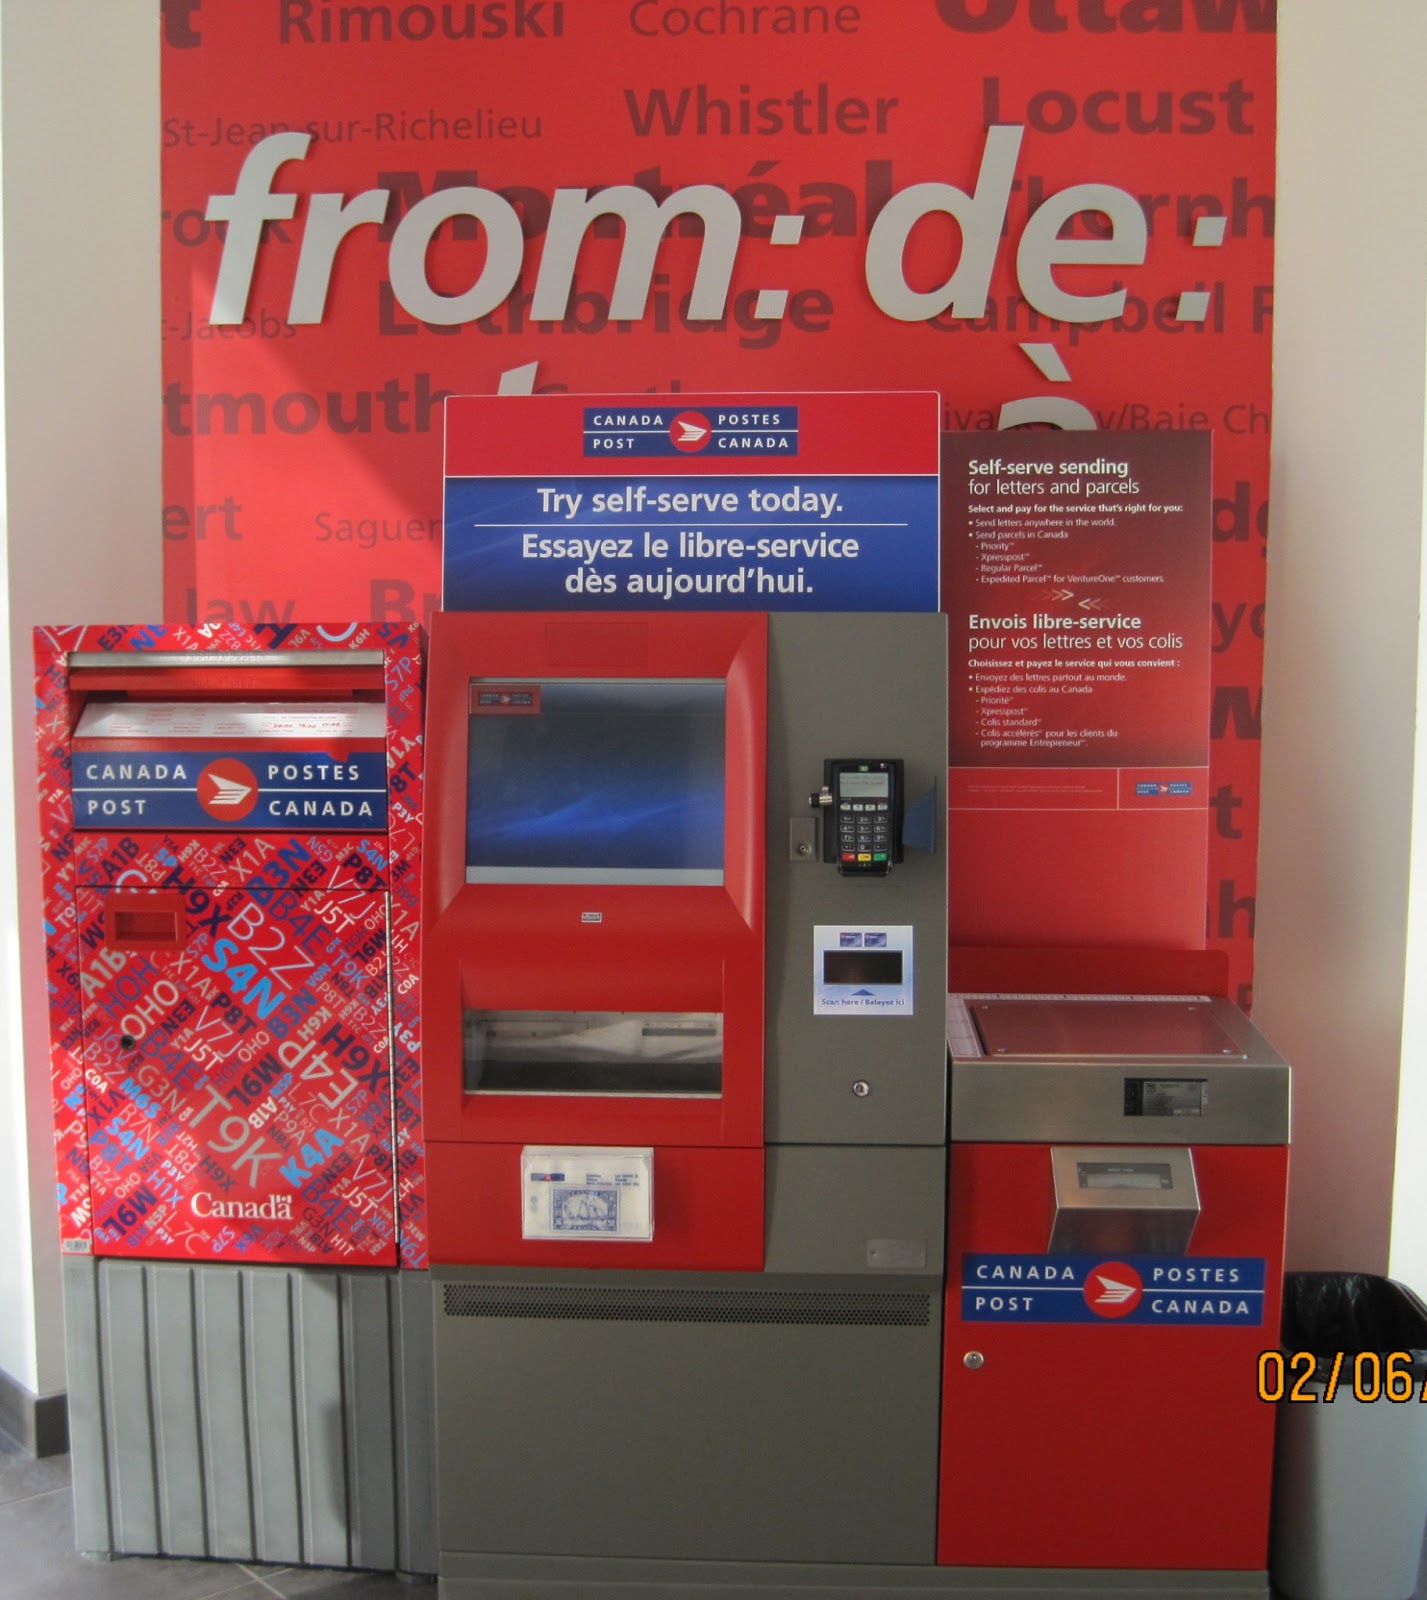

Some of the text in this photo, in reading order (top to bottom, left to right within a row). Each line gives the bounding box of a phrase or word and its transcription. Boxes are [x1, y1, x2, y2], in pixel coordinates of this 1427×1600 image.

[279, 0, 565, 45] Rimouski
[629, 0, 860, 37] Cochrane
[623, 83, 900, 137] Whistler
[982, 76, 1254, 136] Locust
[163, 110, 542, 147] St-Jeansur-Richelieu
[205, 131, 804, 325] from:
[593, 414, 664, 426] CANADA
[718, 414, 781, 425] POSTES
[593, 437, 635, 449] POST
[718, 437, 788, 449] CANADA
[969, 458, 1128, 478] Self-serve sending
[969, 478, 1139, 497] for letters and parcels
[537, 485, 844, 519] Try self-serve today.
[969, 504, 994, 513] Select
[997, 504, 1013, 513] and
[1016, 506, 1031, 514] pay
[1034, 504, 1047, 513] for
[1050, 504, 1064, 513] the
[1066, 504, 1096, 513] service
[1125, 504, 1146, 514] right
[1148, 504, 1161, 513] for
[1164, 506, 1183, 514] you:
[976, 518, 1117, 528] Send letters anywhere in the world.
[976, 530, 1069, 540] Send parcels in Canada
[522, 531, 859, 565] Essayez le libre-service
[981, 564, 1012, 573] Regular
[565, 567, 618, 595] dès
[981, 575, 1020, 584] Expedited
[1054, 575, 1066, 583] for
[969, 613, 1141, 629] Envois libre-service
[969, 632, 1183, 652] pour vos lettres et vos colis
[969, 659, 1012, 667] Choisissez
[1015, 659, 1024, 667] et
[1027, 661, 1052, 669] payez
[1055, 659, 1063, 667] le
[1066, 659, 1095, 667] service
[1098, 659, 1112, 669] qui
[976, 674, 1008, 683] Envoyez
[1010, 673, 1024, 681] des
[1026, 673, 1050, 681] lettres
[1053, 674, 1083, 683] partout
[1097, 673, 1127, 681] monde.
[976, 685, 1011, 694] Expédiez
[1013, 685, 1027, 693] des
[1029, 685, 1047, 693] colis
[1061, 685, 1093, 693] Canada
[981, 718, 1000, 726] Colis
[981, 729, 1000, 737] Colis
[1046, 731, 1064, 739] pour
[1067, 729, 1077, 737] les
[1080, 729, 1105, 737] clients
[1107, 729, 1118, 737] du
[981, 739, 1027, 748] programme
[86, 764, 187, 780] CANADA
[267, 764, 360, 781] POSTES
[88, 799, 147, 815] POST
[268, 800, 373, 817] CANADA
[313, 900, 355, 933] J5T
[227, 901, 315, 990] B2Z
[202, 937, 286, 1020] S4N
[821, 998, 840, 1006] Scan
[841, 998, 859, 1006] here
[864, 998, 894, 1008] Balayez
[895, 998, 905, 1006] ici
[184, 1038, 224, 1071] J5T
[320, 1022, 391, 1095] H9X
[278, 1039, 359, 1110] E4P
[189, 1083, 282, 1189] T9K
[279, 1127, 344, 1188] K4A
[191, 1191, 293, 1220] Canada
[341, 1187, 379, 1216] J5T
[976, 1264, 1076, 1281] CANADA
[1152, 1267, 1240, 1283] POSTES
[975, 1295, 1034, 1311] POST
[1151, 1299, 1250, 1315] CANADA
